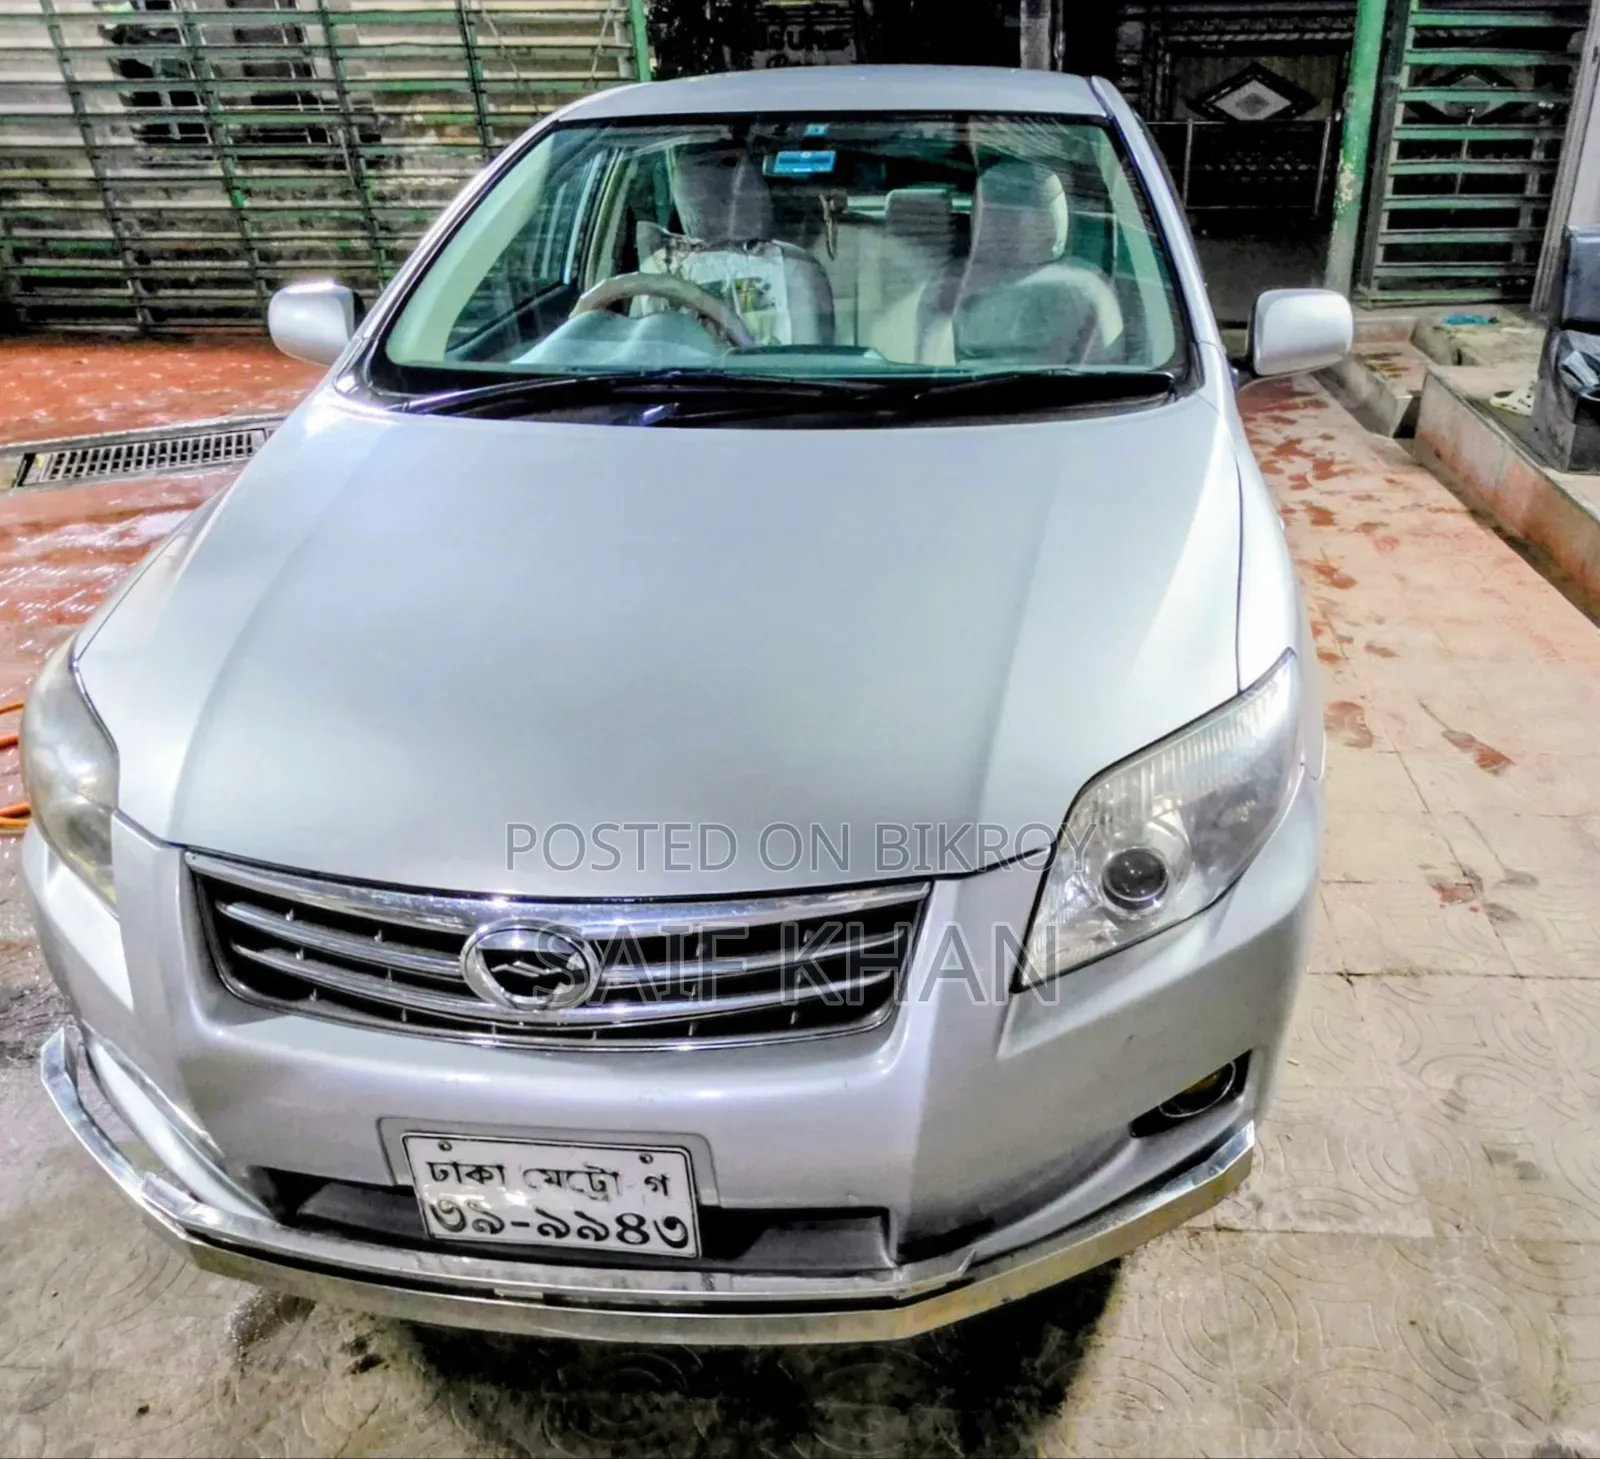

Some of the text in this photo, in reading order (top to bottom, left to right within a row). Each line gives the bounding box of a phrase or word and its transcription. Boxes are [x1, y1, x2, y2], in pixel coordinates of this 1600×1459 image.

[426, 1160, 670, 1202] ঢাকা মেট্রো গ
[429, 1199, 690, 1249] ৩৯-৯৯৪৩
